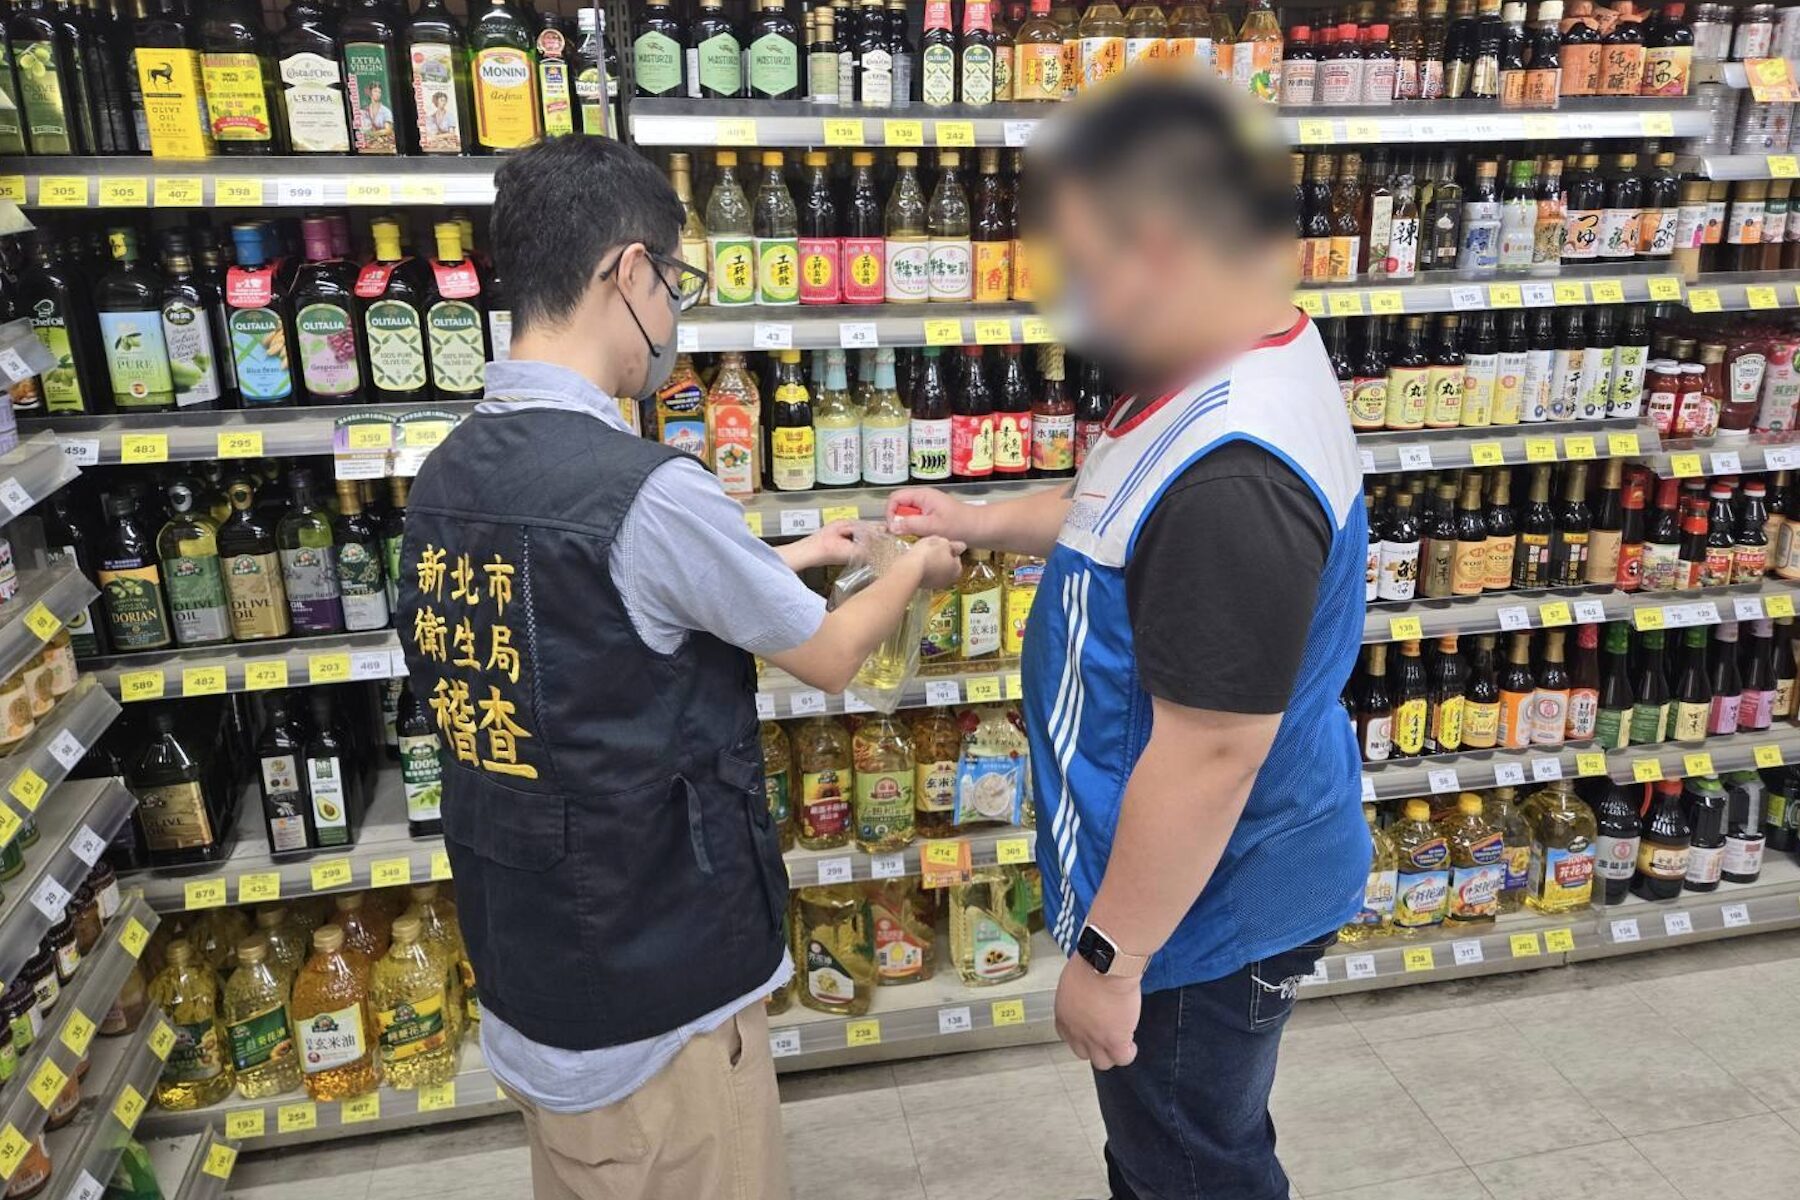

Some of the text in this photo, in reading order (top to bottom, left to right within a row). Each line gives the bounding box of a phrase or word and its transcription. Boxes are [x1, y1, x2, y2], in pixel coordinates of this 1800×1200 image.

[350, 56, 381, 64] EXTRA
[350, 64, 383, 72] VIRGIN
[482, 66, 526, 78] MONINI
[52, 187, 76, 196] 305
[111, 188, 134, 197] 305
[168, 190, 188, 199] 407
[228, 188, 251, 196] 398
[1577, 214, 1599, 246] つゆ
[987, 268, 1004, 290] 香
[235, 321, 276, 331] OLITALIA
[302, 321, 345, 331] OLITALIA
[371, 316, 412, 327] OLITALIA
[433, 317, 473, 327] OLITALIA
[766, 332, 780, 341] 43
[852, 332, 865, 341] 43
[116, 359, 153, 369] PURE
[230, 440, 251, 448] 295
[65, 447, 86, 455] 459
[133, 445, 156, 454] 483
[792, 519, 805, 528] 80
[416, 543, 515, 616] 新北市
[173, 600, 214, 611] OLIVE
[231, 598, 271, 610] OLIVE
[112, 609, 158, 624] DORIAN
[176, 611, 198, 620] OIL
[233, 609, 256, 619] OIL
[414, 605, 521, 684] 衛生局
[320, 662, 340, 672] 203
[256, 671, 276, 680] 473
[131, 681, 154, 690] 589
[193, 677, 215, 686] 482
[428, 677, 538, 780] 稽查
[408, 760, 439, 771] 100%
[934, 848, 950, 856] 214
[315, 1034, 356, 1051] 玄米油
[236, 1119, 254, 1128] 193
